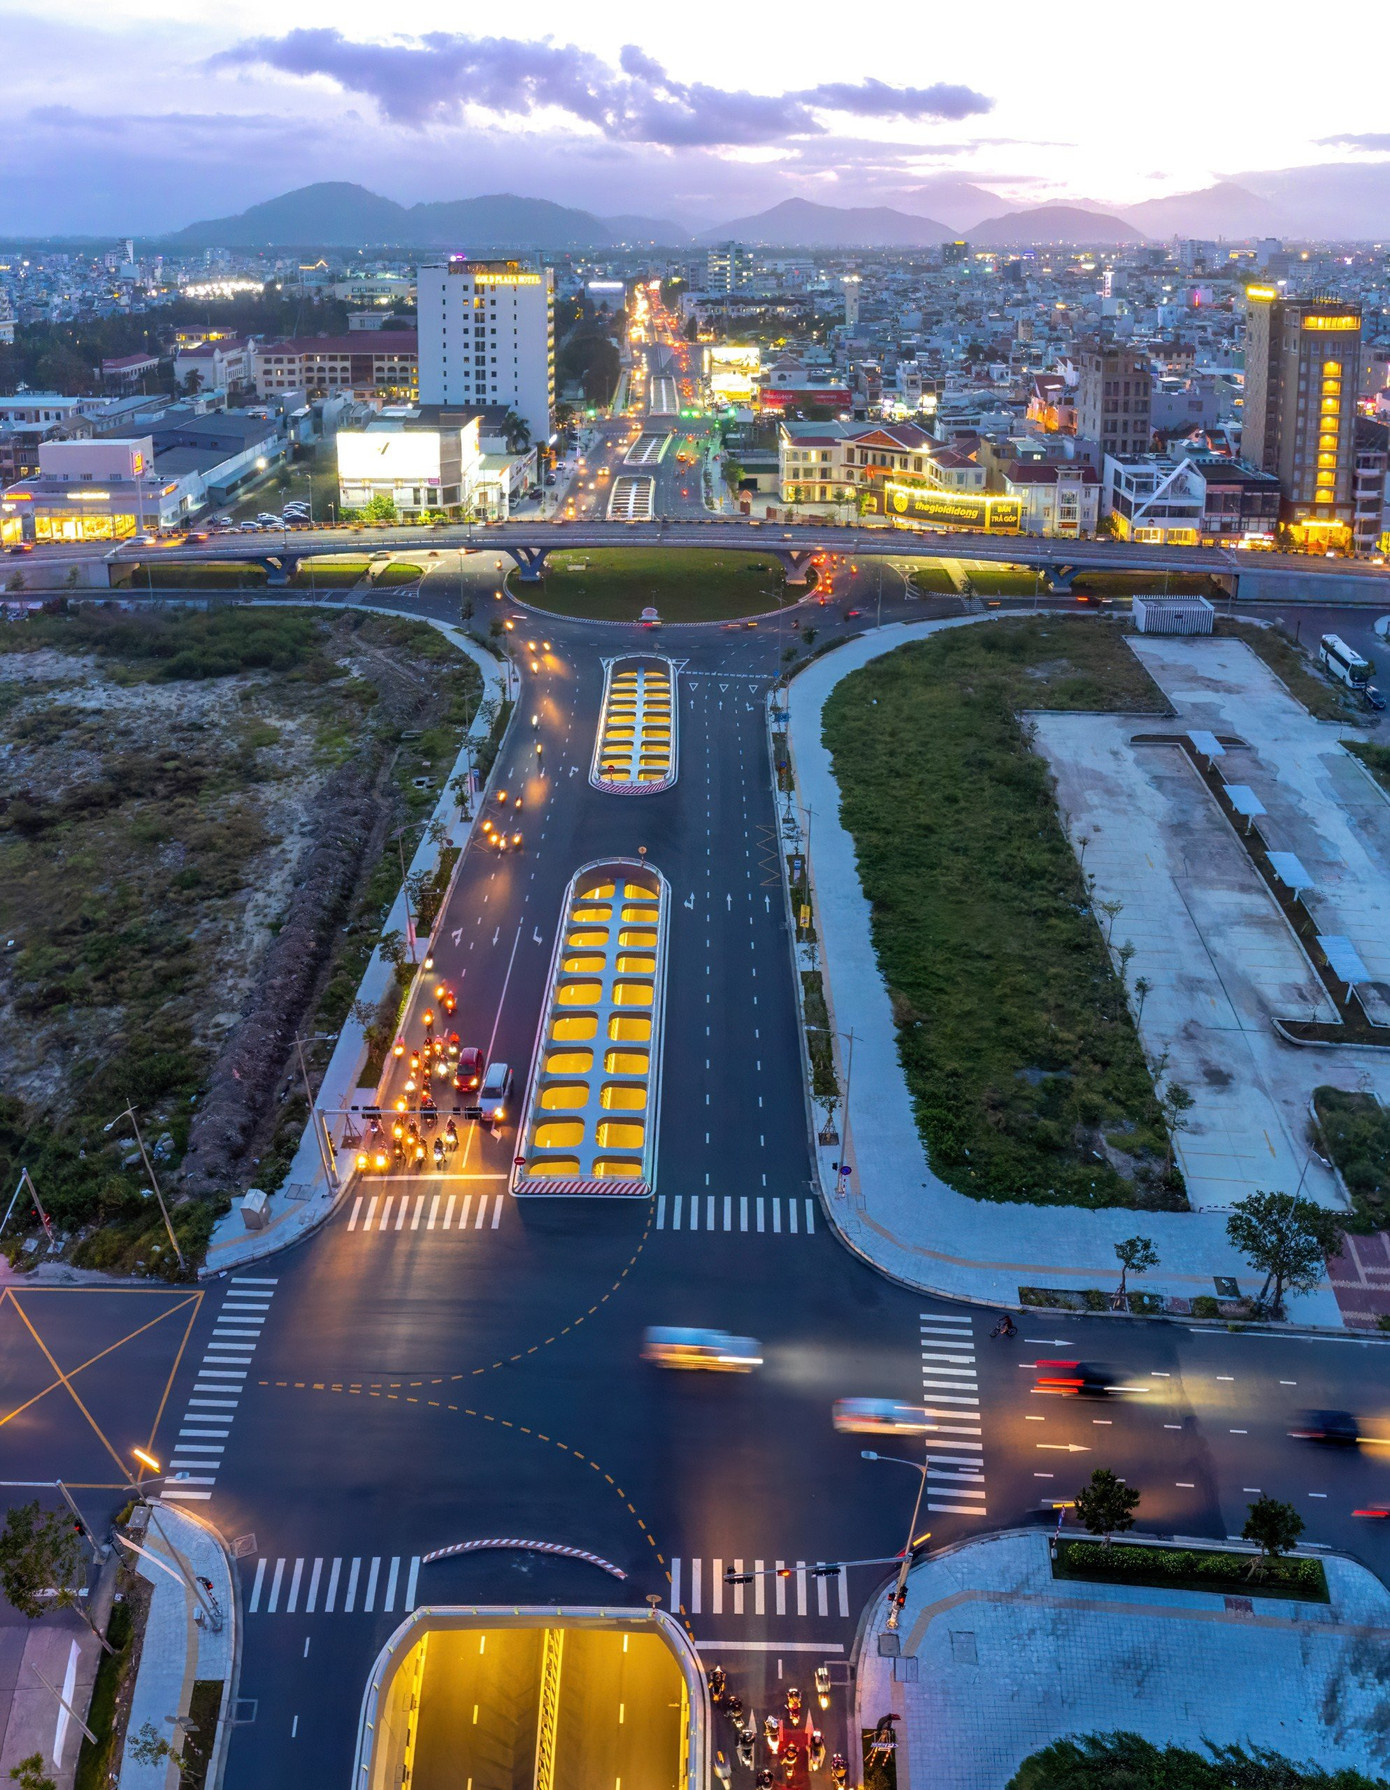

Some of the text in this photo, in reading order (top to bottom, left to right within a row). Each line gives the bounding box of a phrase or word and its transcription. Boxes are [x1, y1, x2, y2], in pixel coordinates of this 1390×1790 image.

[475, 275, 541, 284] GOLD PLAZA HOTEL
